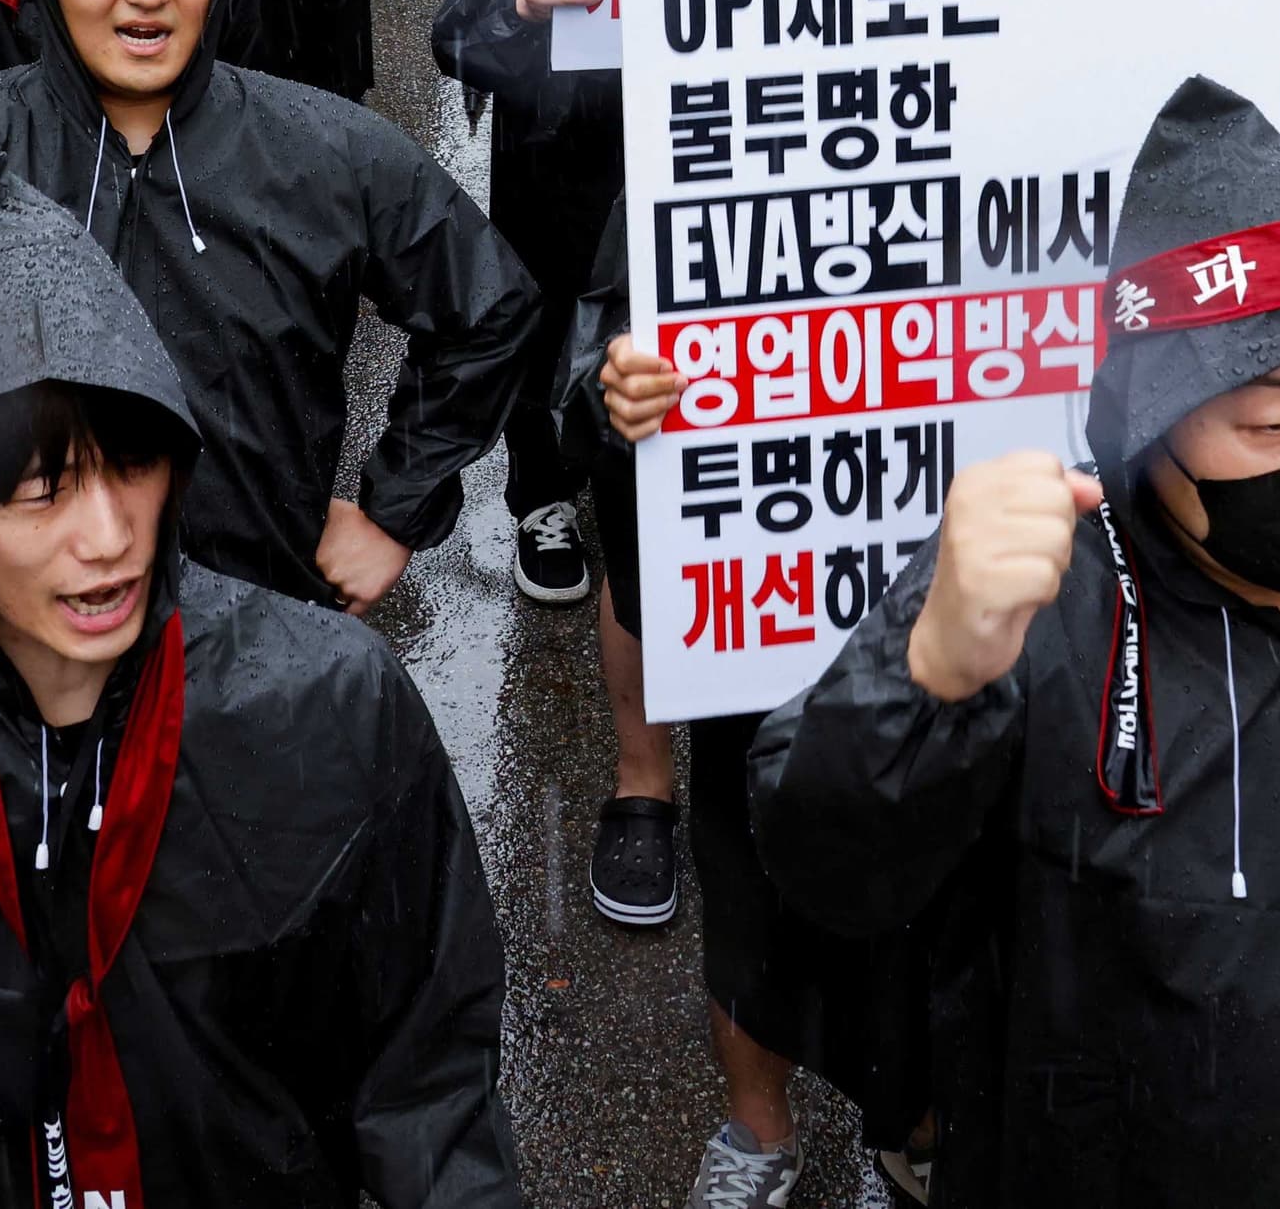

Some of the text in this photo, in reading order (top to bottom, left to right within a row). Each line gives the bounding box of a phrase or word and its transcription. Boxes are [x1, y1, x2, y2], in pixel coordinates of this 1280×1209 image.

[670, 62, 957, 184] 불투명한
[670, 171, 1111, 304] EVA방식 에서
[672, 289, 1098, 432] 영업이익방식
[681, 426, 956, 538] 투명하게
